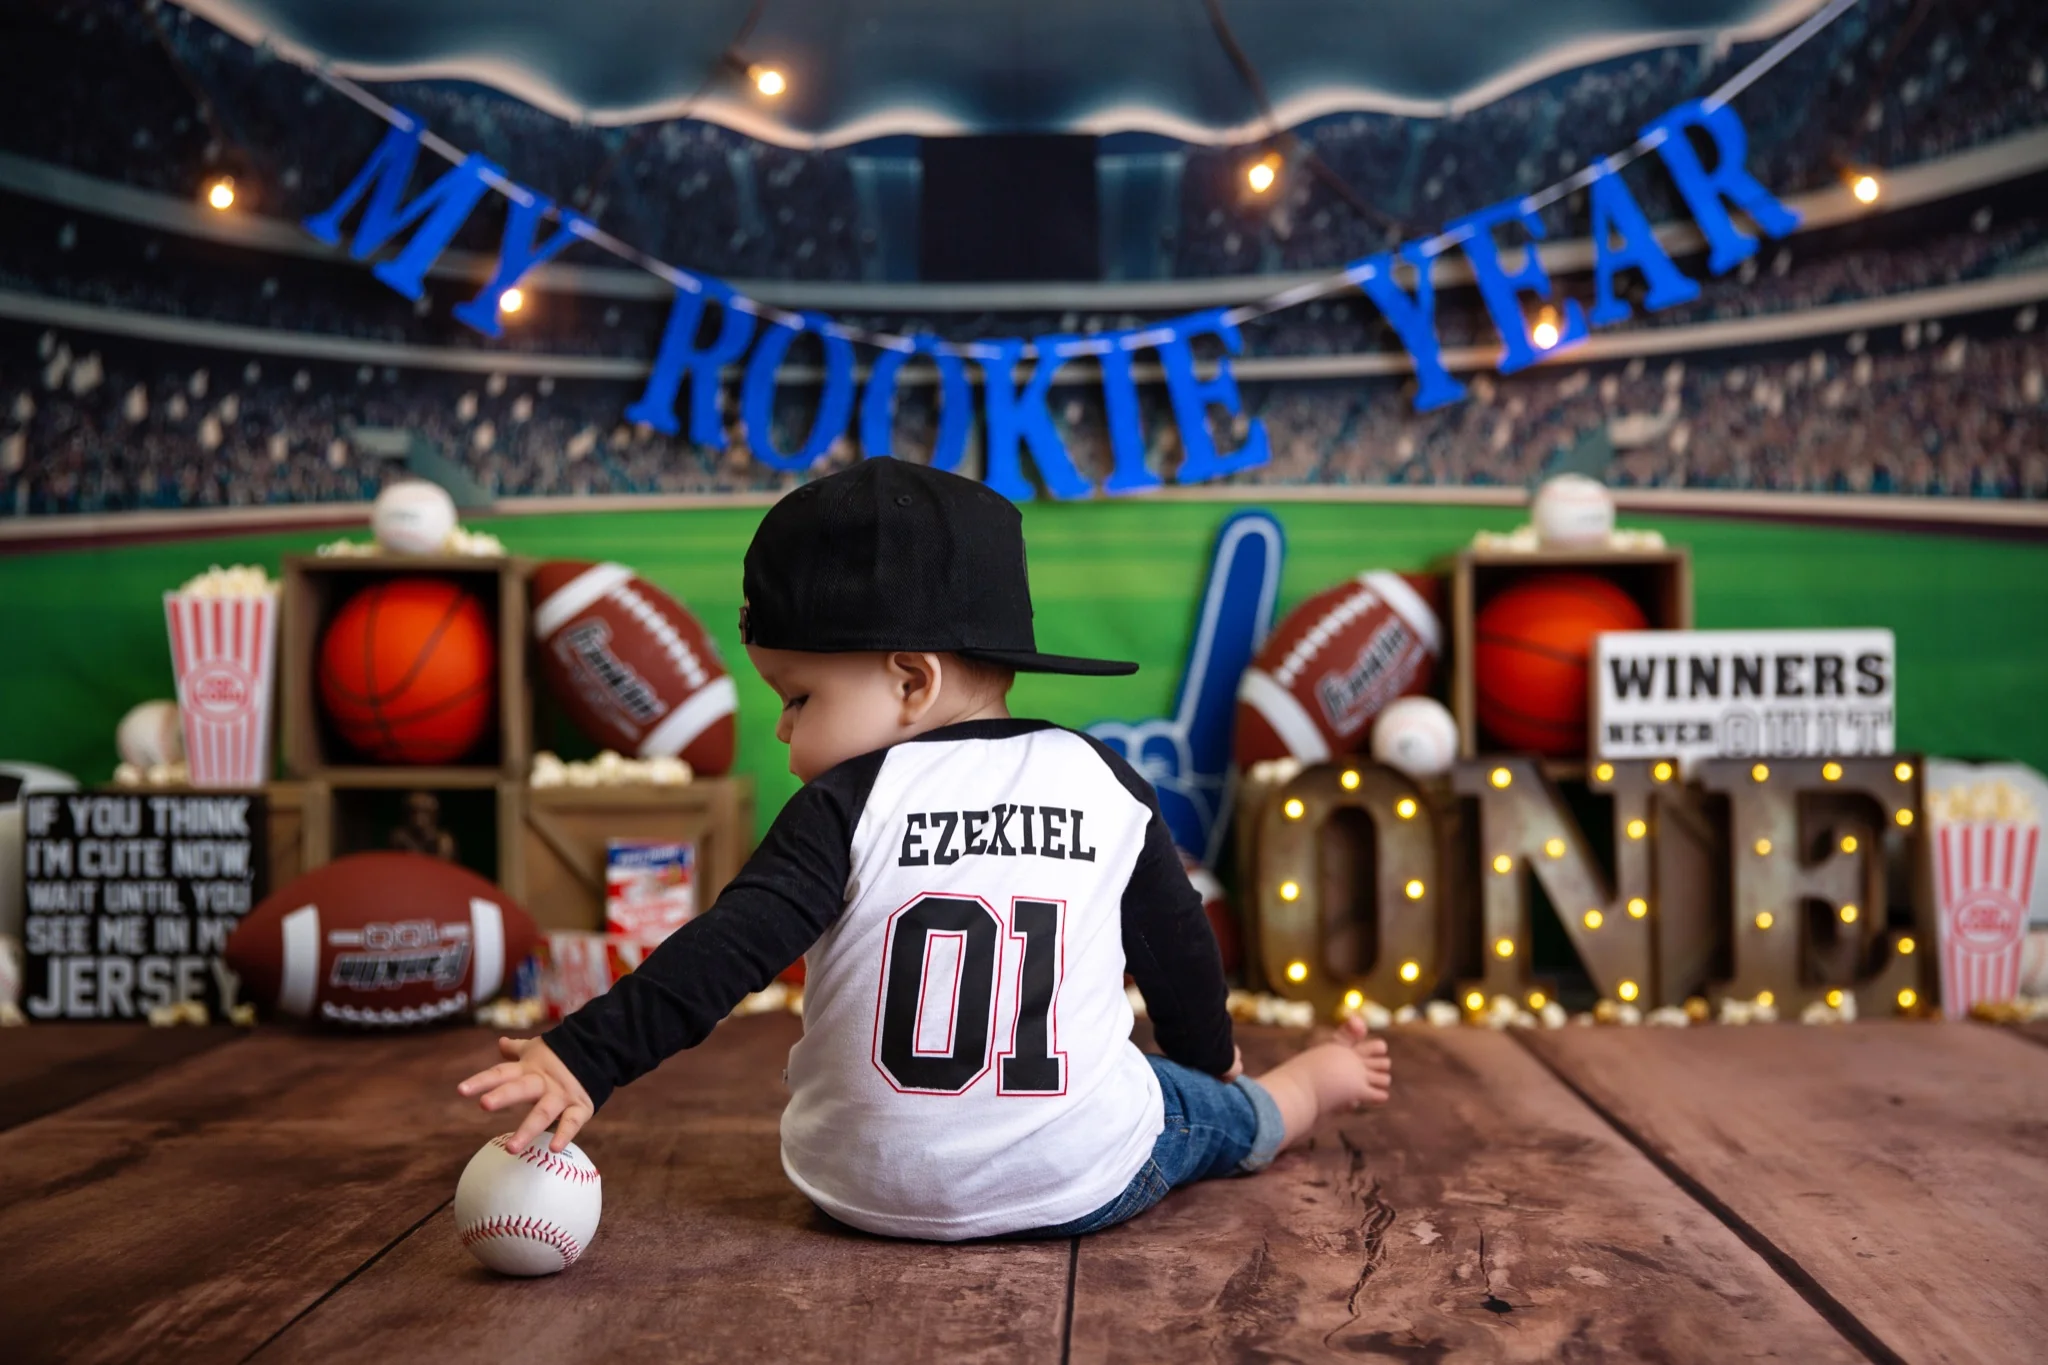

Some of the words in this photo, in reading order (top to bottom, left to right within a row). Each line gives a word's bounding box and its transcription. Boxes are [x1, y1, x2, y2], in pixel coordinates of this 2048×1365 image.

[303, 108, 600, 338] MY
[624, 265, 1273, 501] ROOKIE
[1346, 96, 1802, 412] YEAR
[1609, 653, 1885, 698] WINNERS
[1609, 722, 1713, 744] NEVER
[1719, 703, 1891, 757] QUIT
[27, 797, 58, 835] IF
[68, 797, 141, 835] YOU
[150, 797, 249, 835] THINK
[898, 803, 1096, 867] EZEKIEL
[27, 839, 72, 877] I'M
[78, 839, 166, 877] CUTE
[171, 839, 254, 883] NOW,
[1250, 757, 1920, 1015] ONE
[27, 881, 97, 912] WAIT
[104, 881, 185, 913] UNTIL
[191, 881, 251, 914] YOU
[26, 915, 91, 953] SEE
[97, 916, 148, 952] ME
[154, 916, 190, 952] IN
[26, 955, 240, 1018] JERSEY
[871, 891, 1068, 1097] 01
